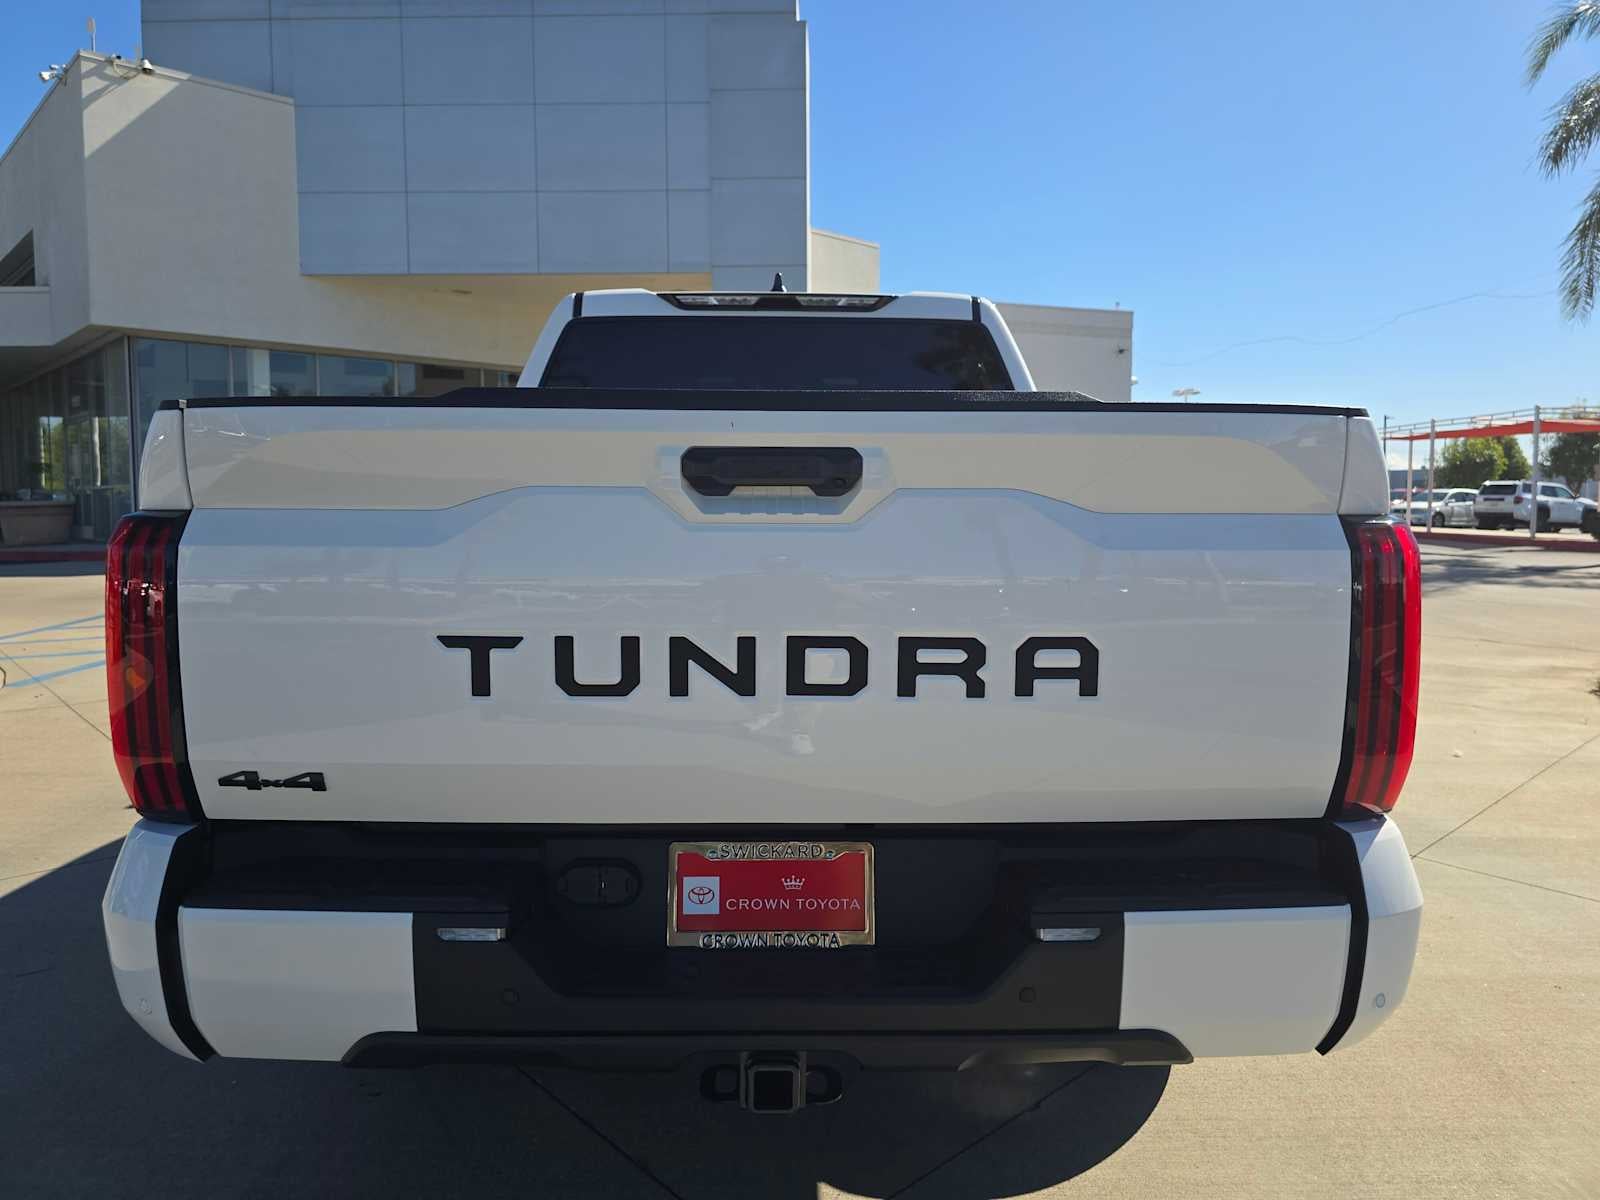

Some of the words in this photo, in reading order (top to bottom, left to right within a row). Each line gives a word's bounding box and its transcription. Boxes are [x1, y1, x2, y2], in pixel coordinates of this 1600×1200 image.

[437, 636, 1099, 698] TUNDRA
[719, 843, 824, 859] SWICKARD
[725, 898, 790, 910] CROWN
[796, 898, 861, 910] TOYOTA
[701, 933, 769, 948] CROWN
[774, 933, 840, 948] TOYOTA
